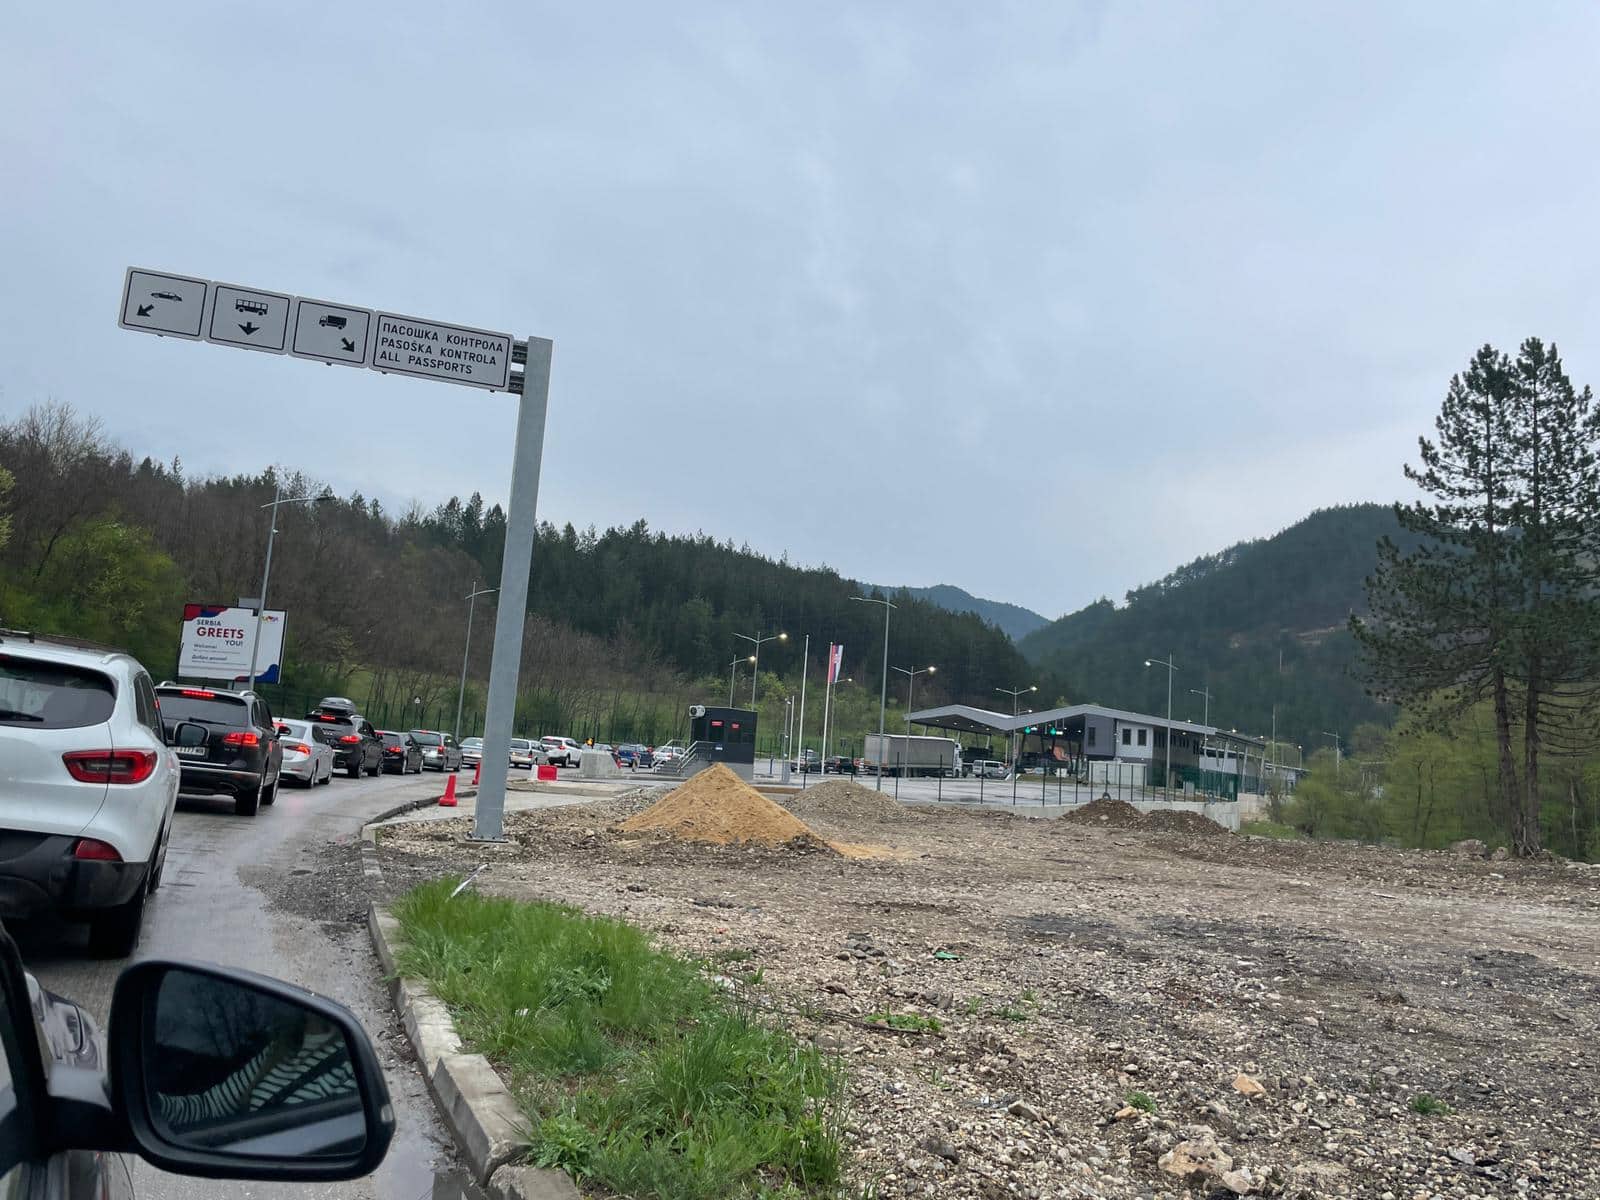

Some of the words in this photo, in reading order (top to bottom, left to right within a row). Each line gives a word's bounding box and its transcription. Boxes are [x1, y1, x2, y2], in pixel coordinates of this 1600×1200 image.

[383, 323, 439, 342] ПАСОШКА
[446, 335, 503, 352] КОНТРОЛА
[380, 350, 401, 363] ALL
[408, 356, 472, 374] PASSPORTS
[440, 347, 496, 366] KONTROLA
[196, 626, 244, 639] GREETS
[224, 639, 243, 647] YOU!
